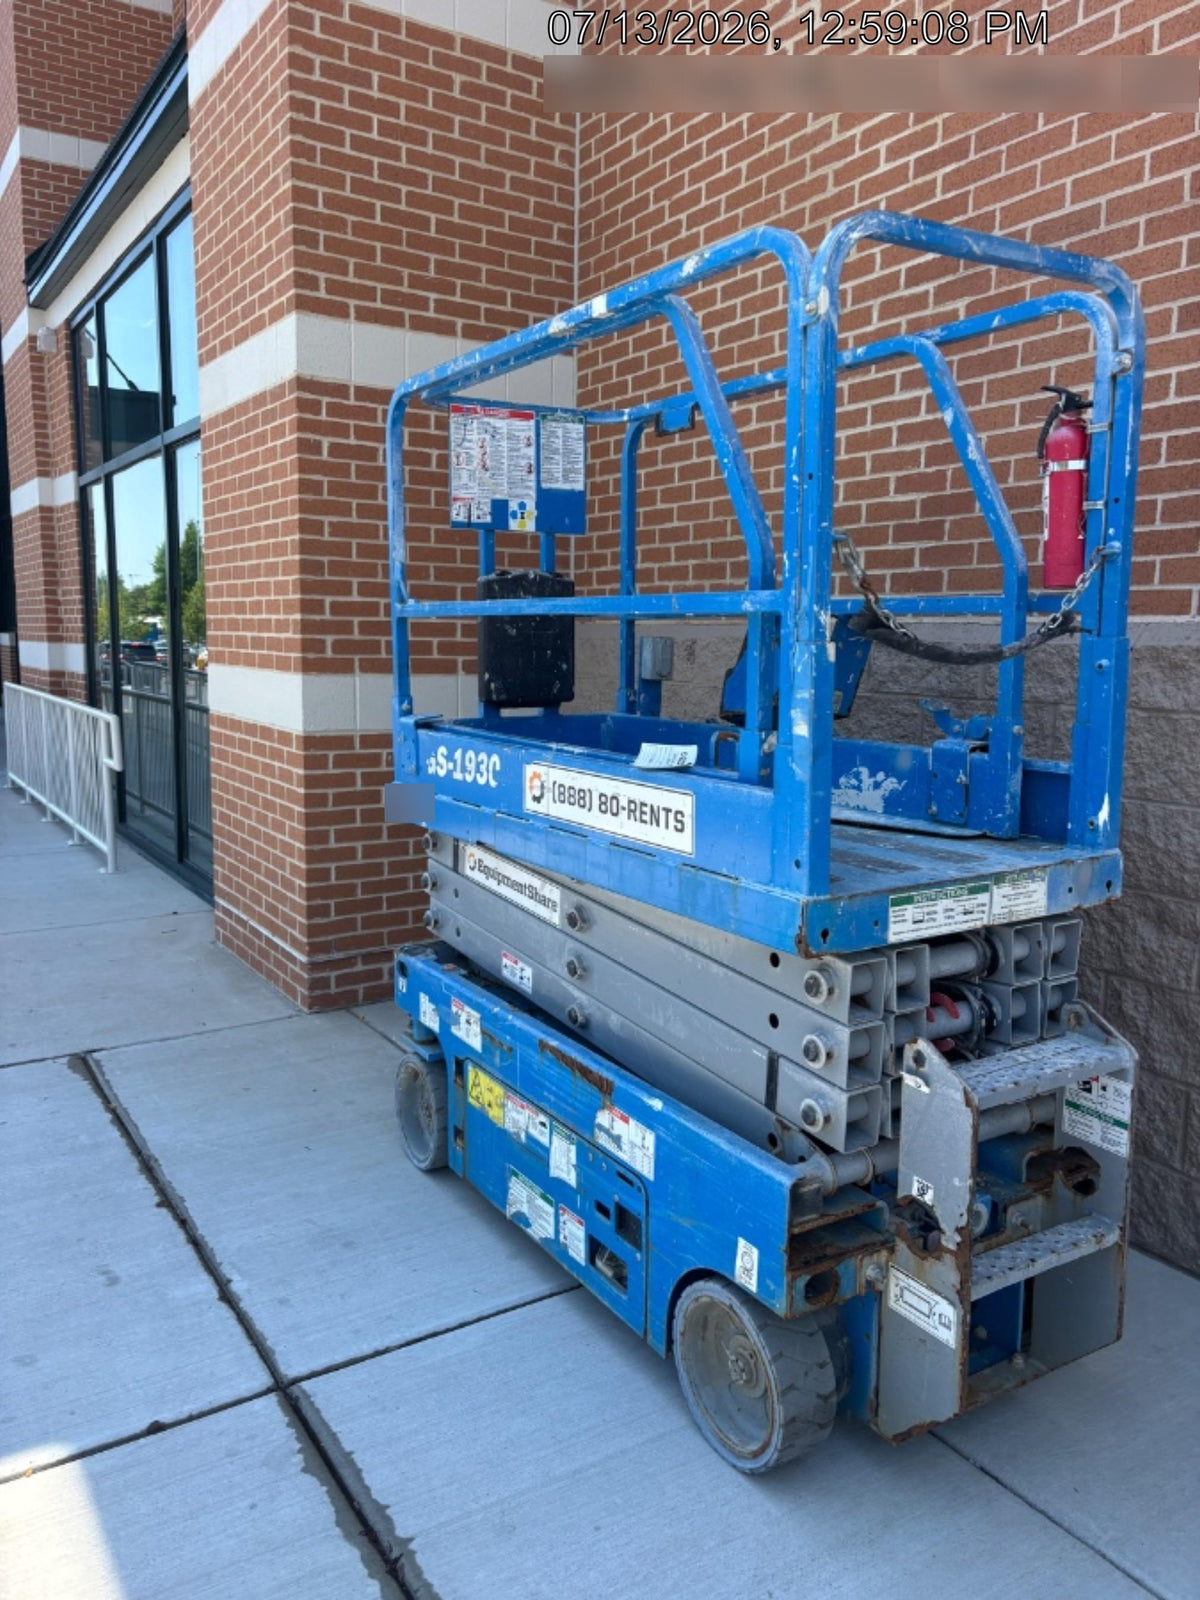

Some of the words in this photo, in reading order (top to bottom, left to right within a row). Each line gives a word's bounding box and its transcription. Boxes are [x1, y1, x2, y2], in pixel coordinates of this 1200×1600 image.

[551, 780, 593, 813] (888)
[598, 792, 686, 833] 80-RENTS
[477, 858, 558, 913] EquipmentShare
